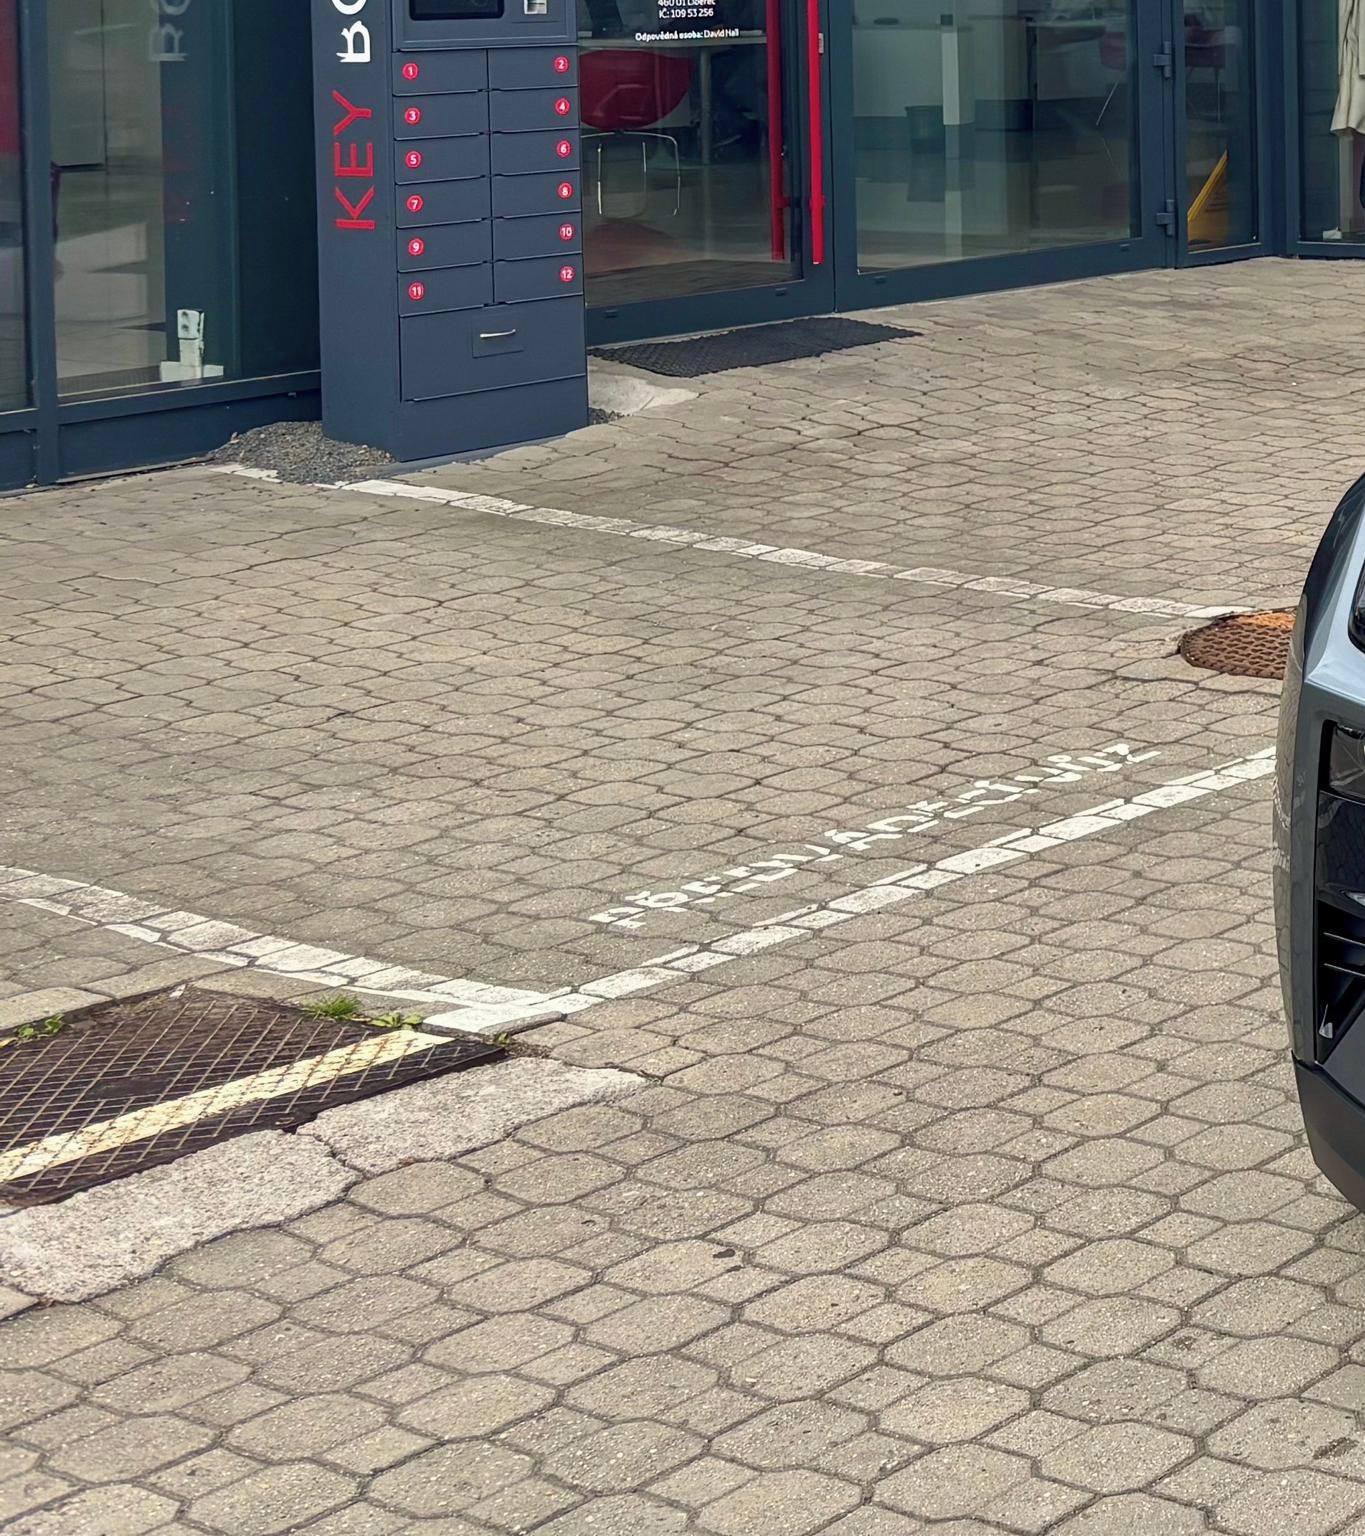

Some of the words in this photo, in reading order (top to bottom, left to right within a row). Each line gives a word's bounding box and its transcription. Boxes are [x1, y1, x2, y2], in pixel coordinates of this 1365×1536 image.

[671, 9, 686, 18] 109
[687, 9, 697, 17] 53
[698, 8, 714, 17] 256
[635, 30, 678, 42] Odpovědná
[704, 29, 724, 38] David
[558, 60, 565, 69] 2
[407, 66, 414, 76] 1
[559, 102, 566, 111] 4
[409, 111, 416, 121] 3
[560, 144, 567, 153] 6
[332, 89, 375, 230] KEY
[410, 155, 417, 164] 5
[562, 186, 569, 196] 8
[411, 200, 419, 210] 7
[561, 227, 573, 237] 10
[412, 242, 420, 252] 9
[561, 269, 573, 279] 12
[411, 286, 423, 296] 11
